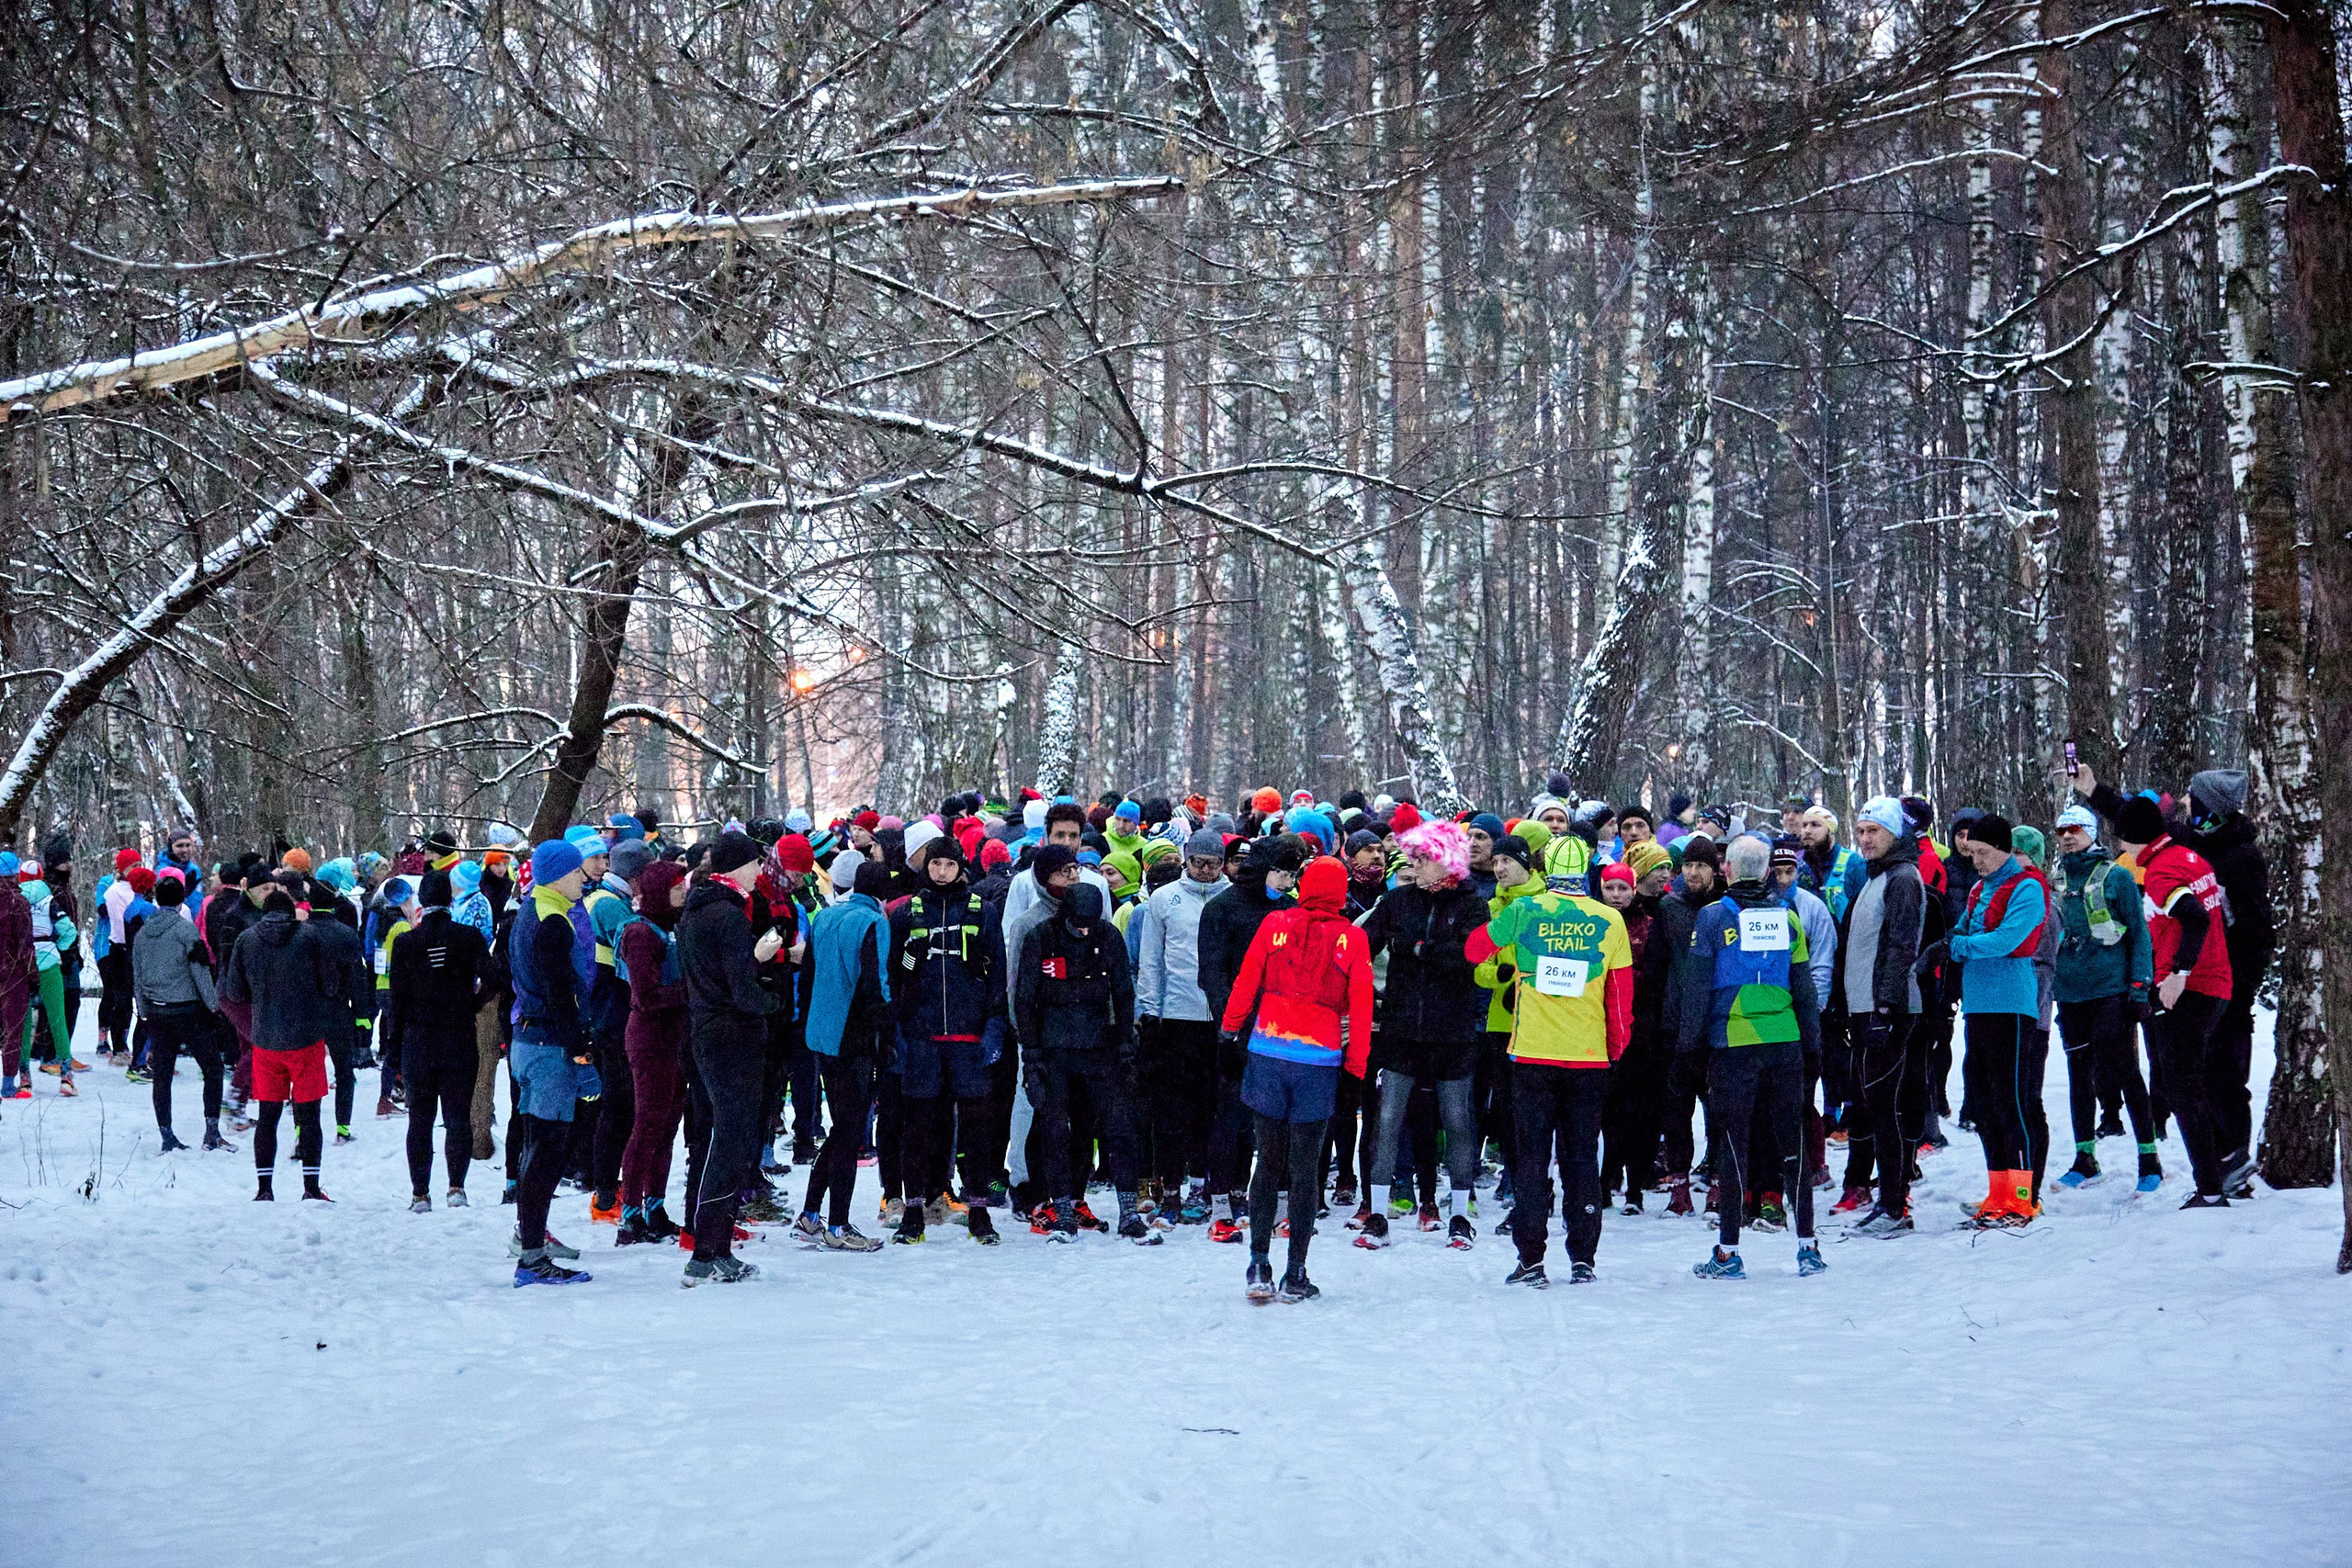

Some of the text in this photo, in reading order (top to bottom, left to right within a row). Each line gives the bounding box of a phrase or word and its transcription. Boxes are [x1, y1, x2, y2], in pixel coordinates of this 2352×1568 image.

[1538, 922, 1596, 938] BLIZKO
[1748, 921, 1762, 931] 26
[1544, 937, 1590, 953] TRAIL
[1544, 965, 1559, 976] 26
